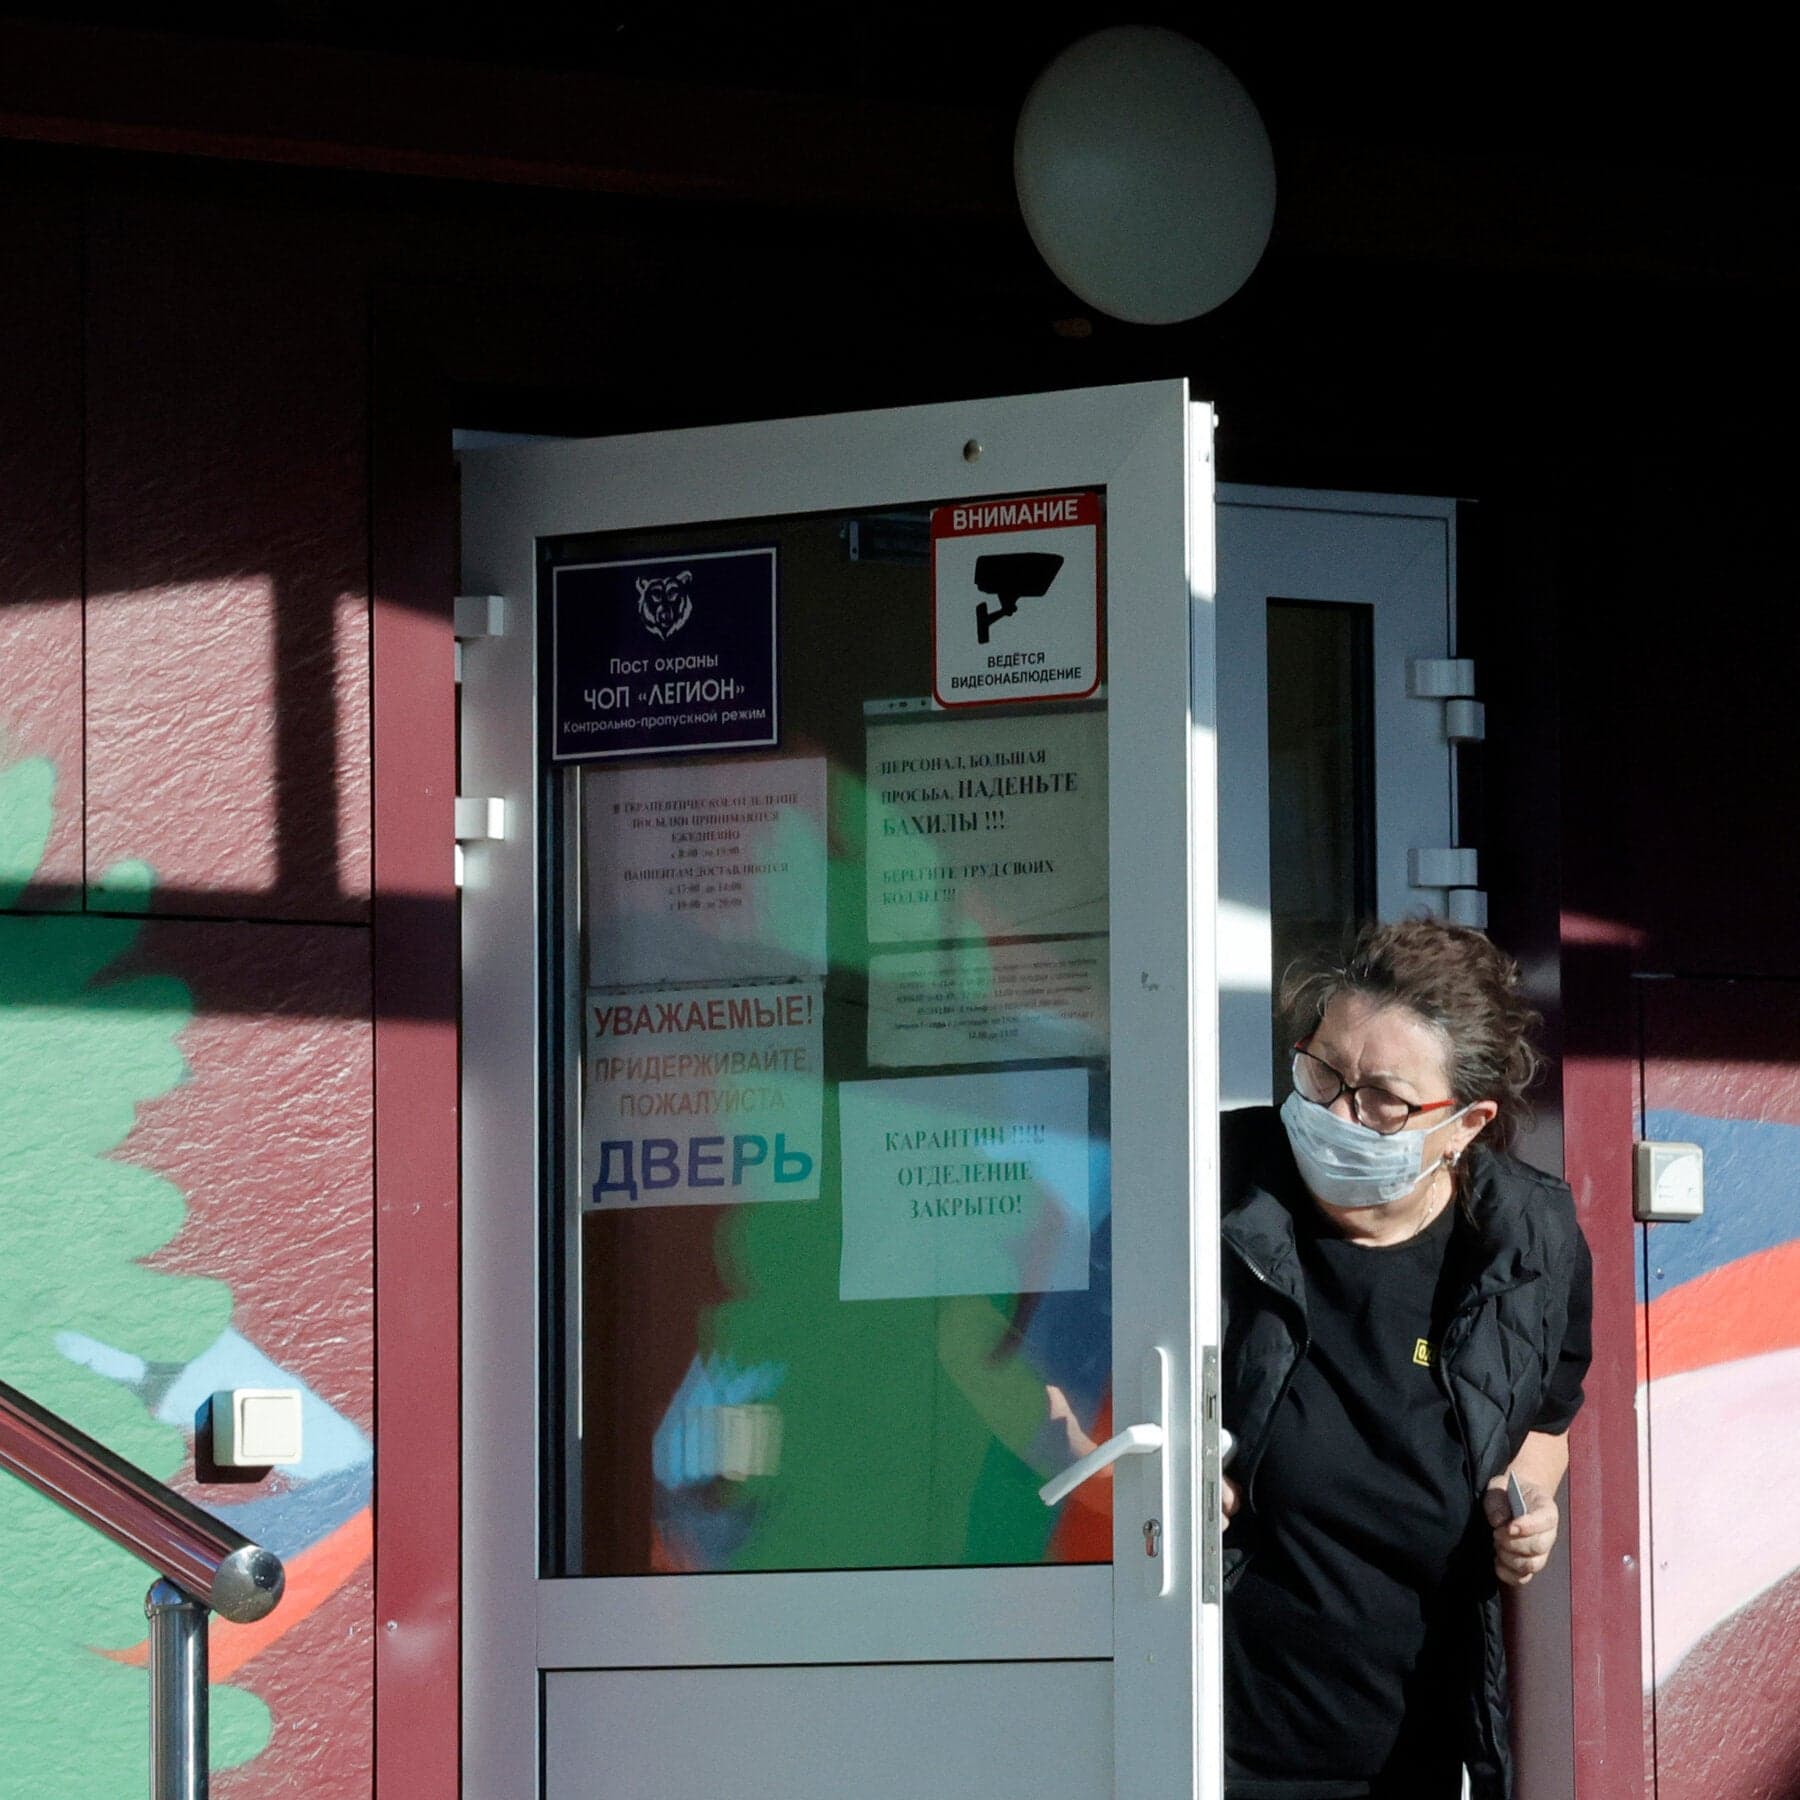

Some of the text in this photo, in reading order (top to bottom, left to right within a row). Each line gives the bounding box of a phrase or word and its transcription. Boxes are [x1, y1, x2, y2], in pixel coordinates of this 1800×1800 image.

[953, 499, 1078, 530] ВНИМАНИЕ
[610, 654, 719, 675] Пост охраны
[988, 652, 1045, 669] ВЕДЁТСЯ
[951, 667, 1082, 689] ВИДЕОНАБЛЮДЕНИЕ
[584, 678, 745, 710] ЧОП «ЛЕГИОН»
[563, 708, 766, 734] Контрольно-пропускной режим
[969, 749, 1047, 769] БОЛЬШАЯ
[958, 772, 1080, 800] НАДЕНЬТЕ
[882, 811, 978, 837] БАХИЛЫ
[594, 995, 812, 1038] УВАЖАЕМЫЕ!
[885, 1125, 1004, 1152] КАРАНТИН
[592, 1132, 813, 1204] ДВЕРЬ
[898, 1160, 1033, 1187] ОТДЕЛЕНИЕ
[911, 1194, 1023, 1220] ЗАКРЫТО!
